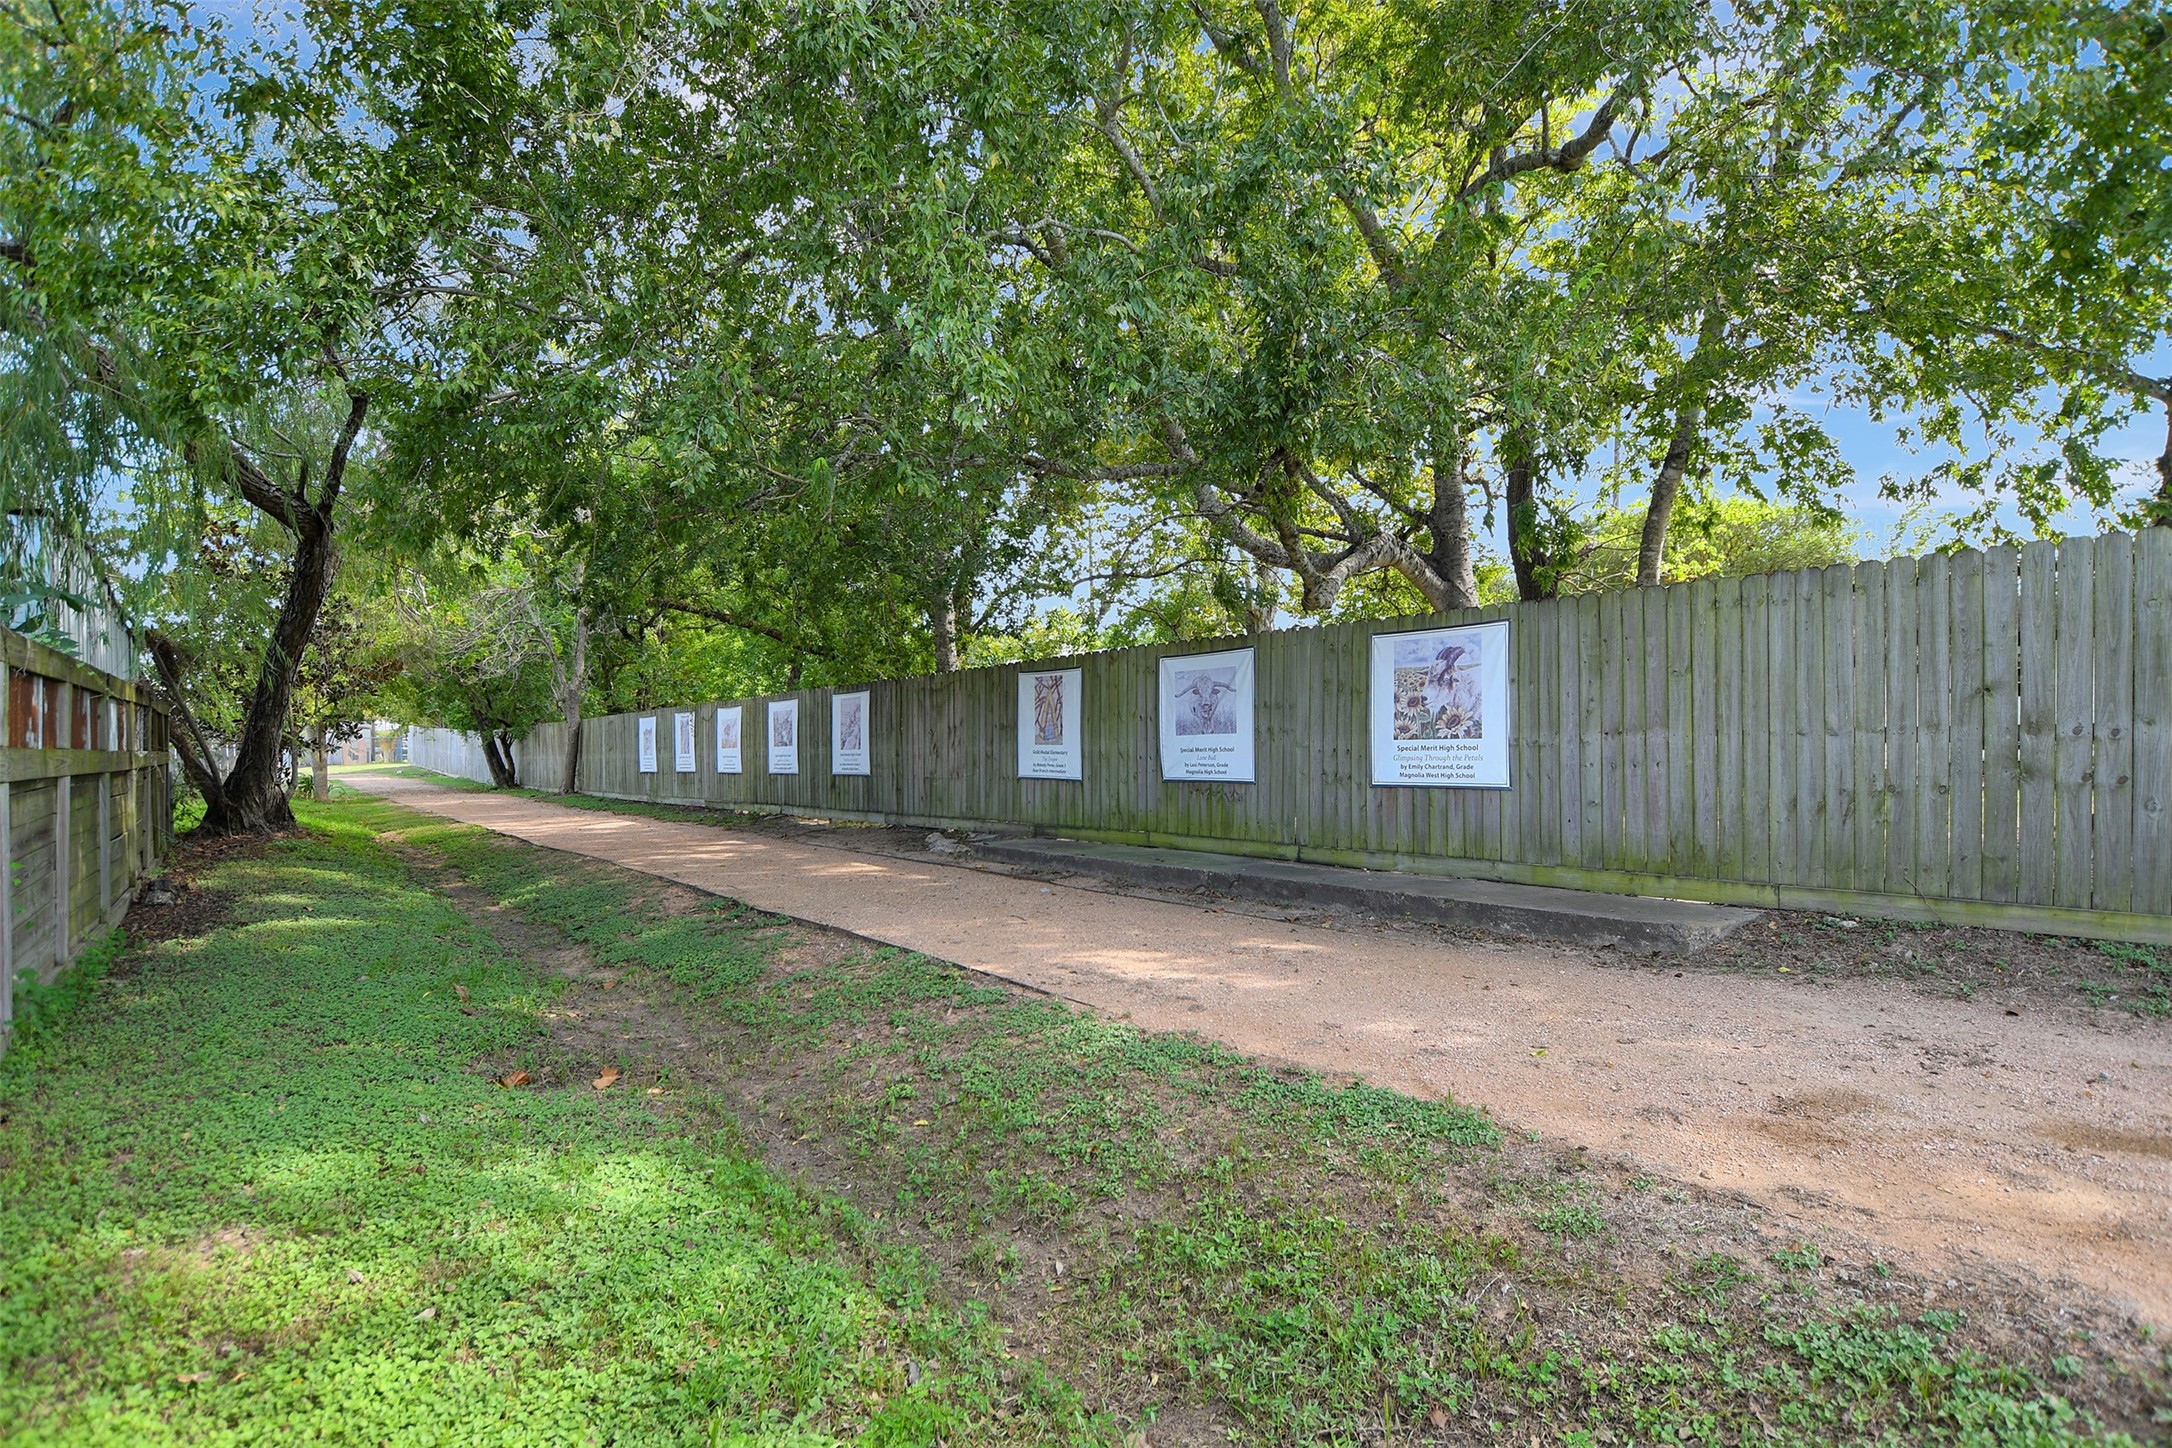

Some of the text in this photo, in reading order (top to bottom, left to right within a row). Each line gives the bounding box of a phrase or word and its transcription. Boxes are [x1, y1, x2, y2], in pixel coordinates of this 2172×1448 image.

[1397, 745, 1419, 753] Special
[1439, 744, 1454, 752] High
[1425, 755, 1451, 763] Through
